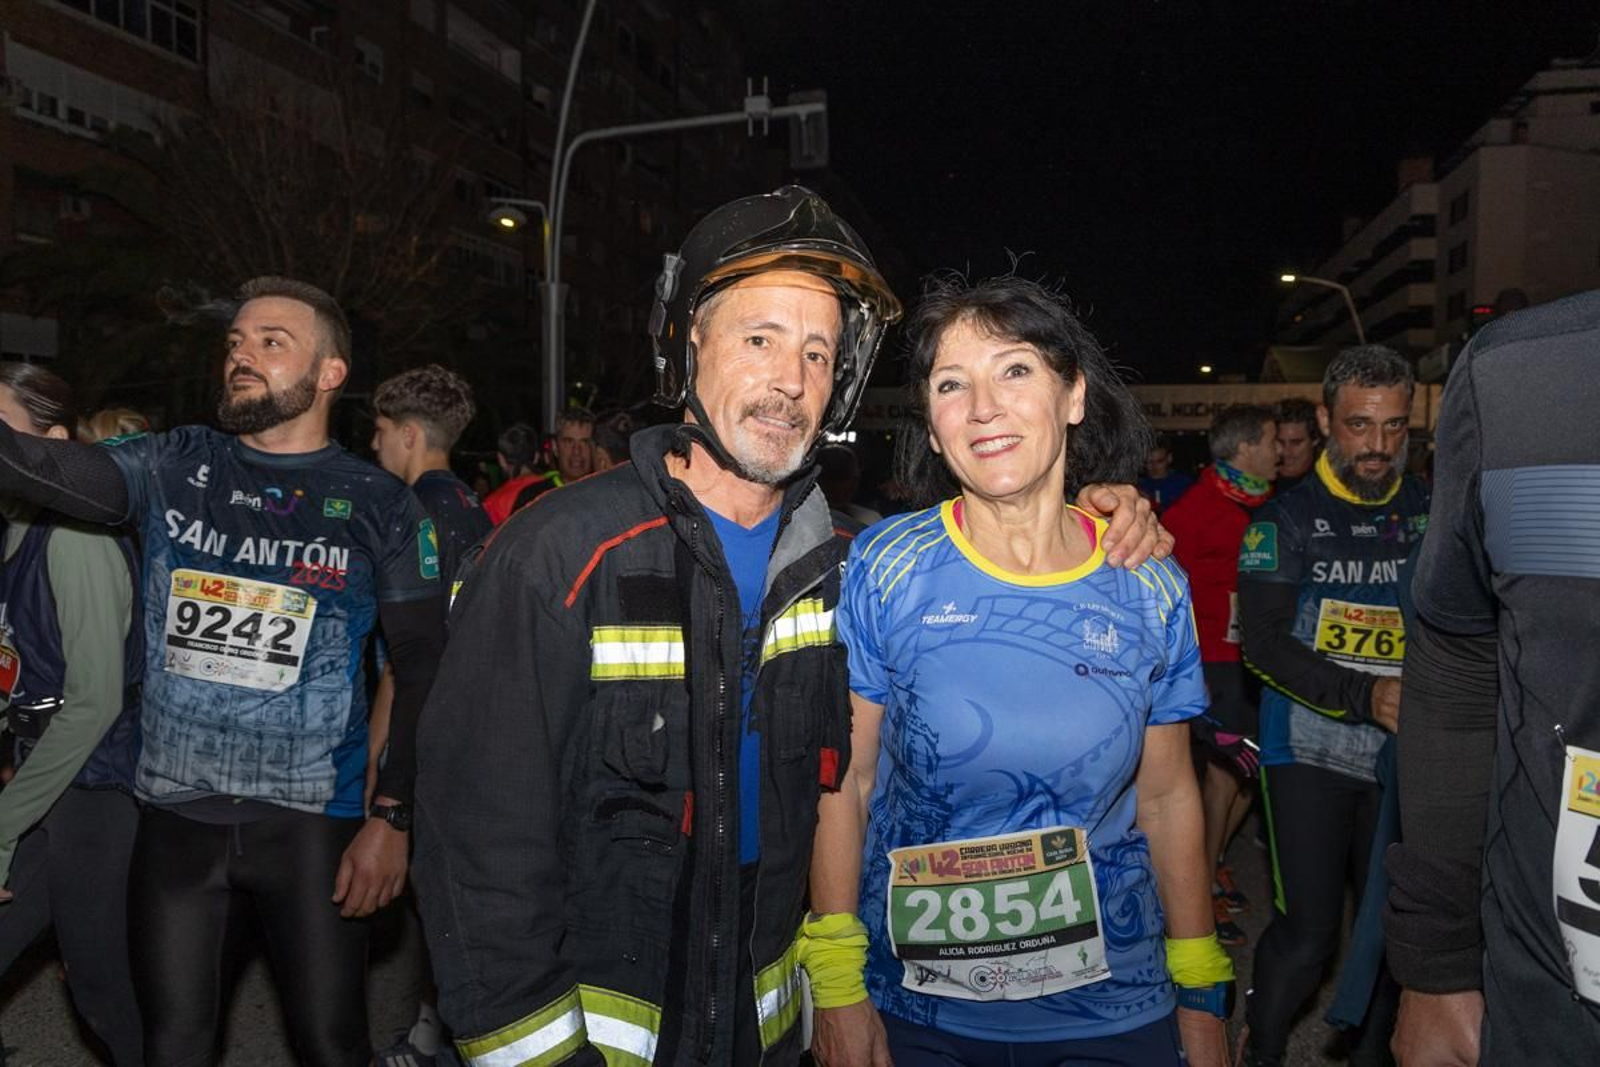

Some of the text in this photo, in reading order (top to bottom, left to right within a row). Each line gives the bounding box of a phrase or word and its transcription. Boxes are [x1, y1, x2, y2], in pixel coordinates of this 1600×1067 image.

[165, 508, 349, 575] SAN ANTÓN
[290, 561, 348, 591] 2025
[1312, 560, 1363, 583] SAN
[200, 578, 225, 598] 42
[175, 600, 297, 653] 9242
[1344, 608, 1365, 621] 42
[1325, 624, 1407, 656] 376
[928, 849, 962, 877] 42
[961, 859, 990, 874] SAN
[904, 871, 1082, 942] 2854
[939, 934, 1057, 957] ALICIA RODRÍGUEZ ORDUÑA
